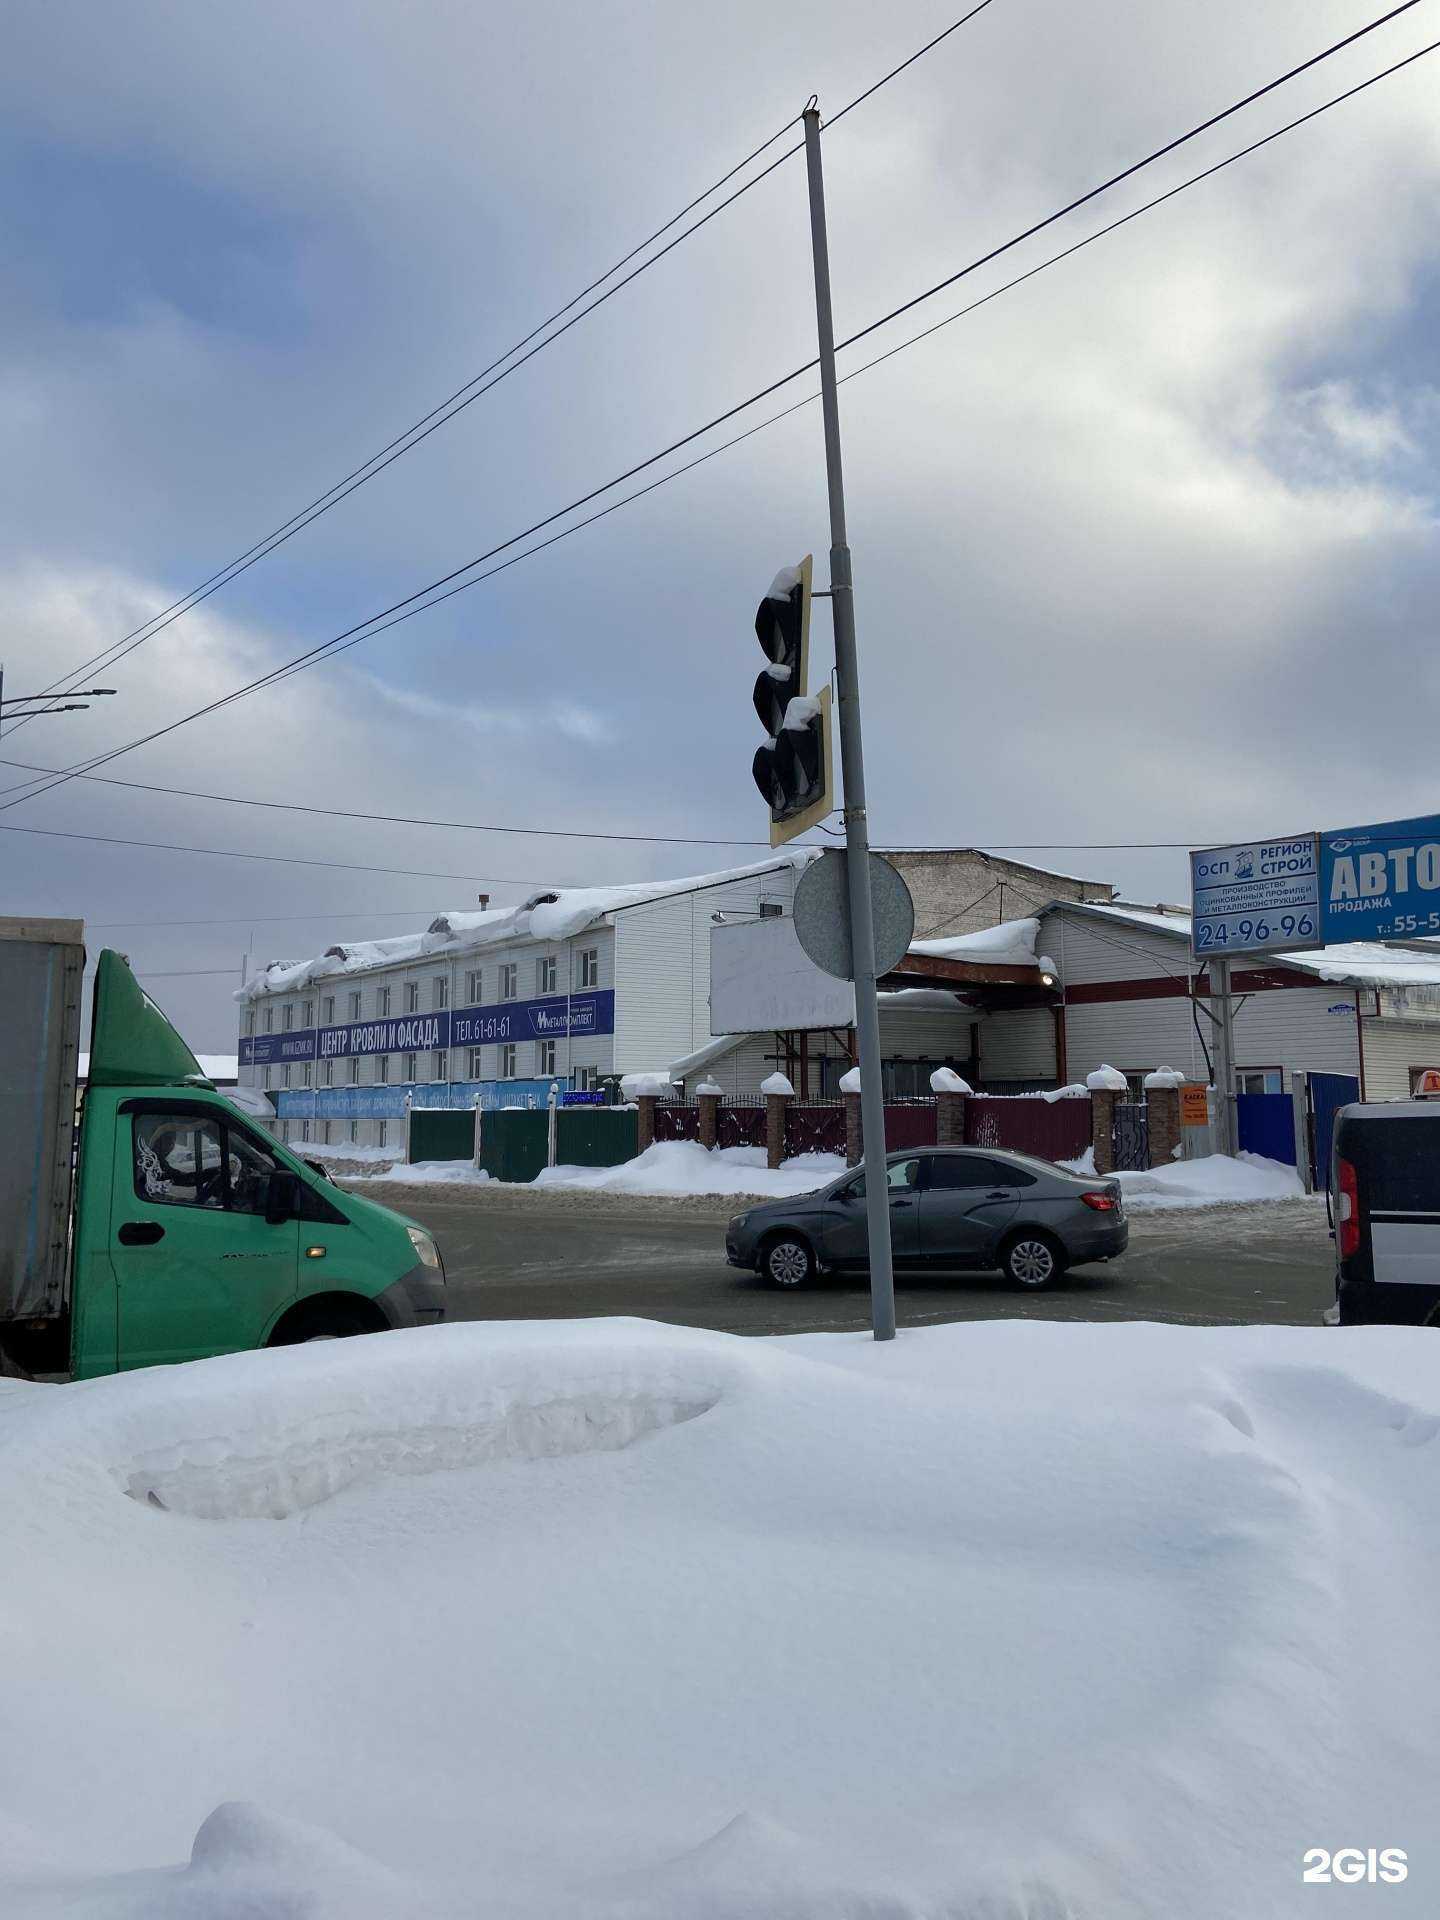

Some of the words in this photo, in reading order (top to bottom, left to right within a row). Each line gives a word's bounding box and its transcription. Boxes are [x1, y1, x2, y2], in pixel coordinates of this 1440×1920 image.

[1261, 841, 1312, 859] РЕГИОН
[1199, 861, 1229, 876] ОСП
[1261, 854, 1312, 875] СТРОЙ
[1330, 843, 1440, 901] АВТО
[1200, 891, 1263, 906] ОЦИНКОВАННЫХ
[1265, 885, 1312, 898] ПРОФИЛЕЙ
[1222, 881, 1285, 895] ПРОИЗВОДСТВО
[1329, 897, 1392, 913] ПРОДАЖА
[1200, 914, 1313, 946] 24-96-96
[321, 1031, 347, 1058] ЦЕНТР
[351, 1025, 386, 1052] КРОВЛИ
[389, 1023, 396, 1048] И
[398, 1018, 439, 1049] ФАСАДА
[456, 1020, 473, 1041] ТЕЛ.
[475, 1016, 511, 1038] 61-61-61
